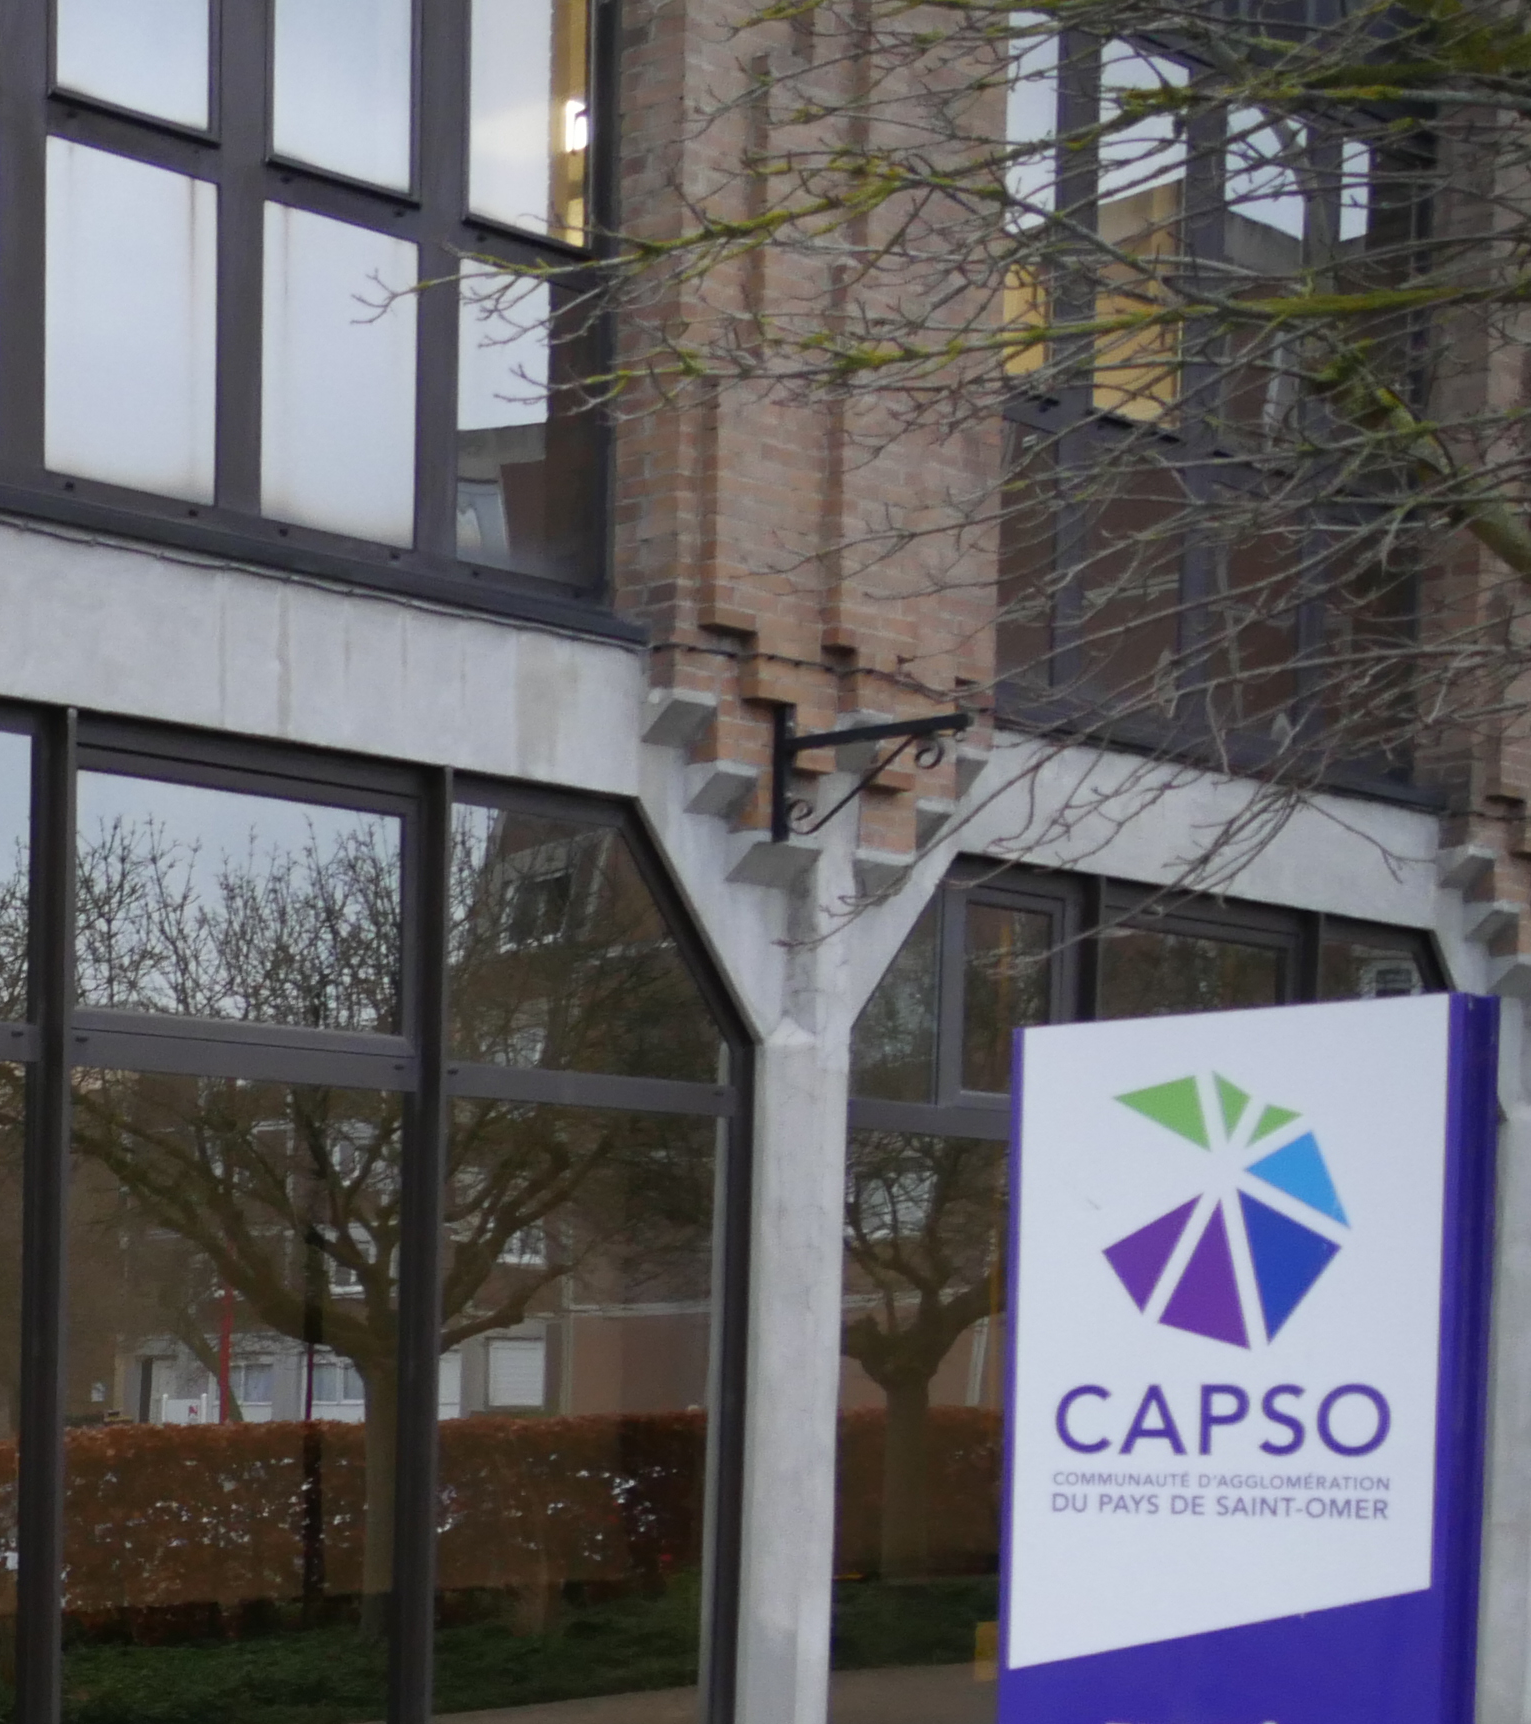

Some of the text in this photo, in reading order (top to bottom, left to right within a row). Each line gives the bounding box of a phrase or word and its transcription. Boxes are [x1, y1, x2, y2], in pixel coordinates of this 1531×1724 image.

[1054, 1382, 1392, 1458] CAPSO
[1052, 1470, 1392, 1492] COMMUNAUTÉ D'AGGLOMÉRATION
[1051, 1493, 1390, 1521] DU PAYS DE SAINT-OMER
